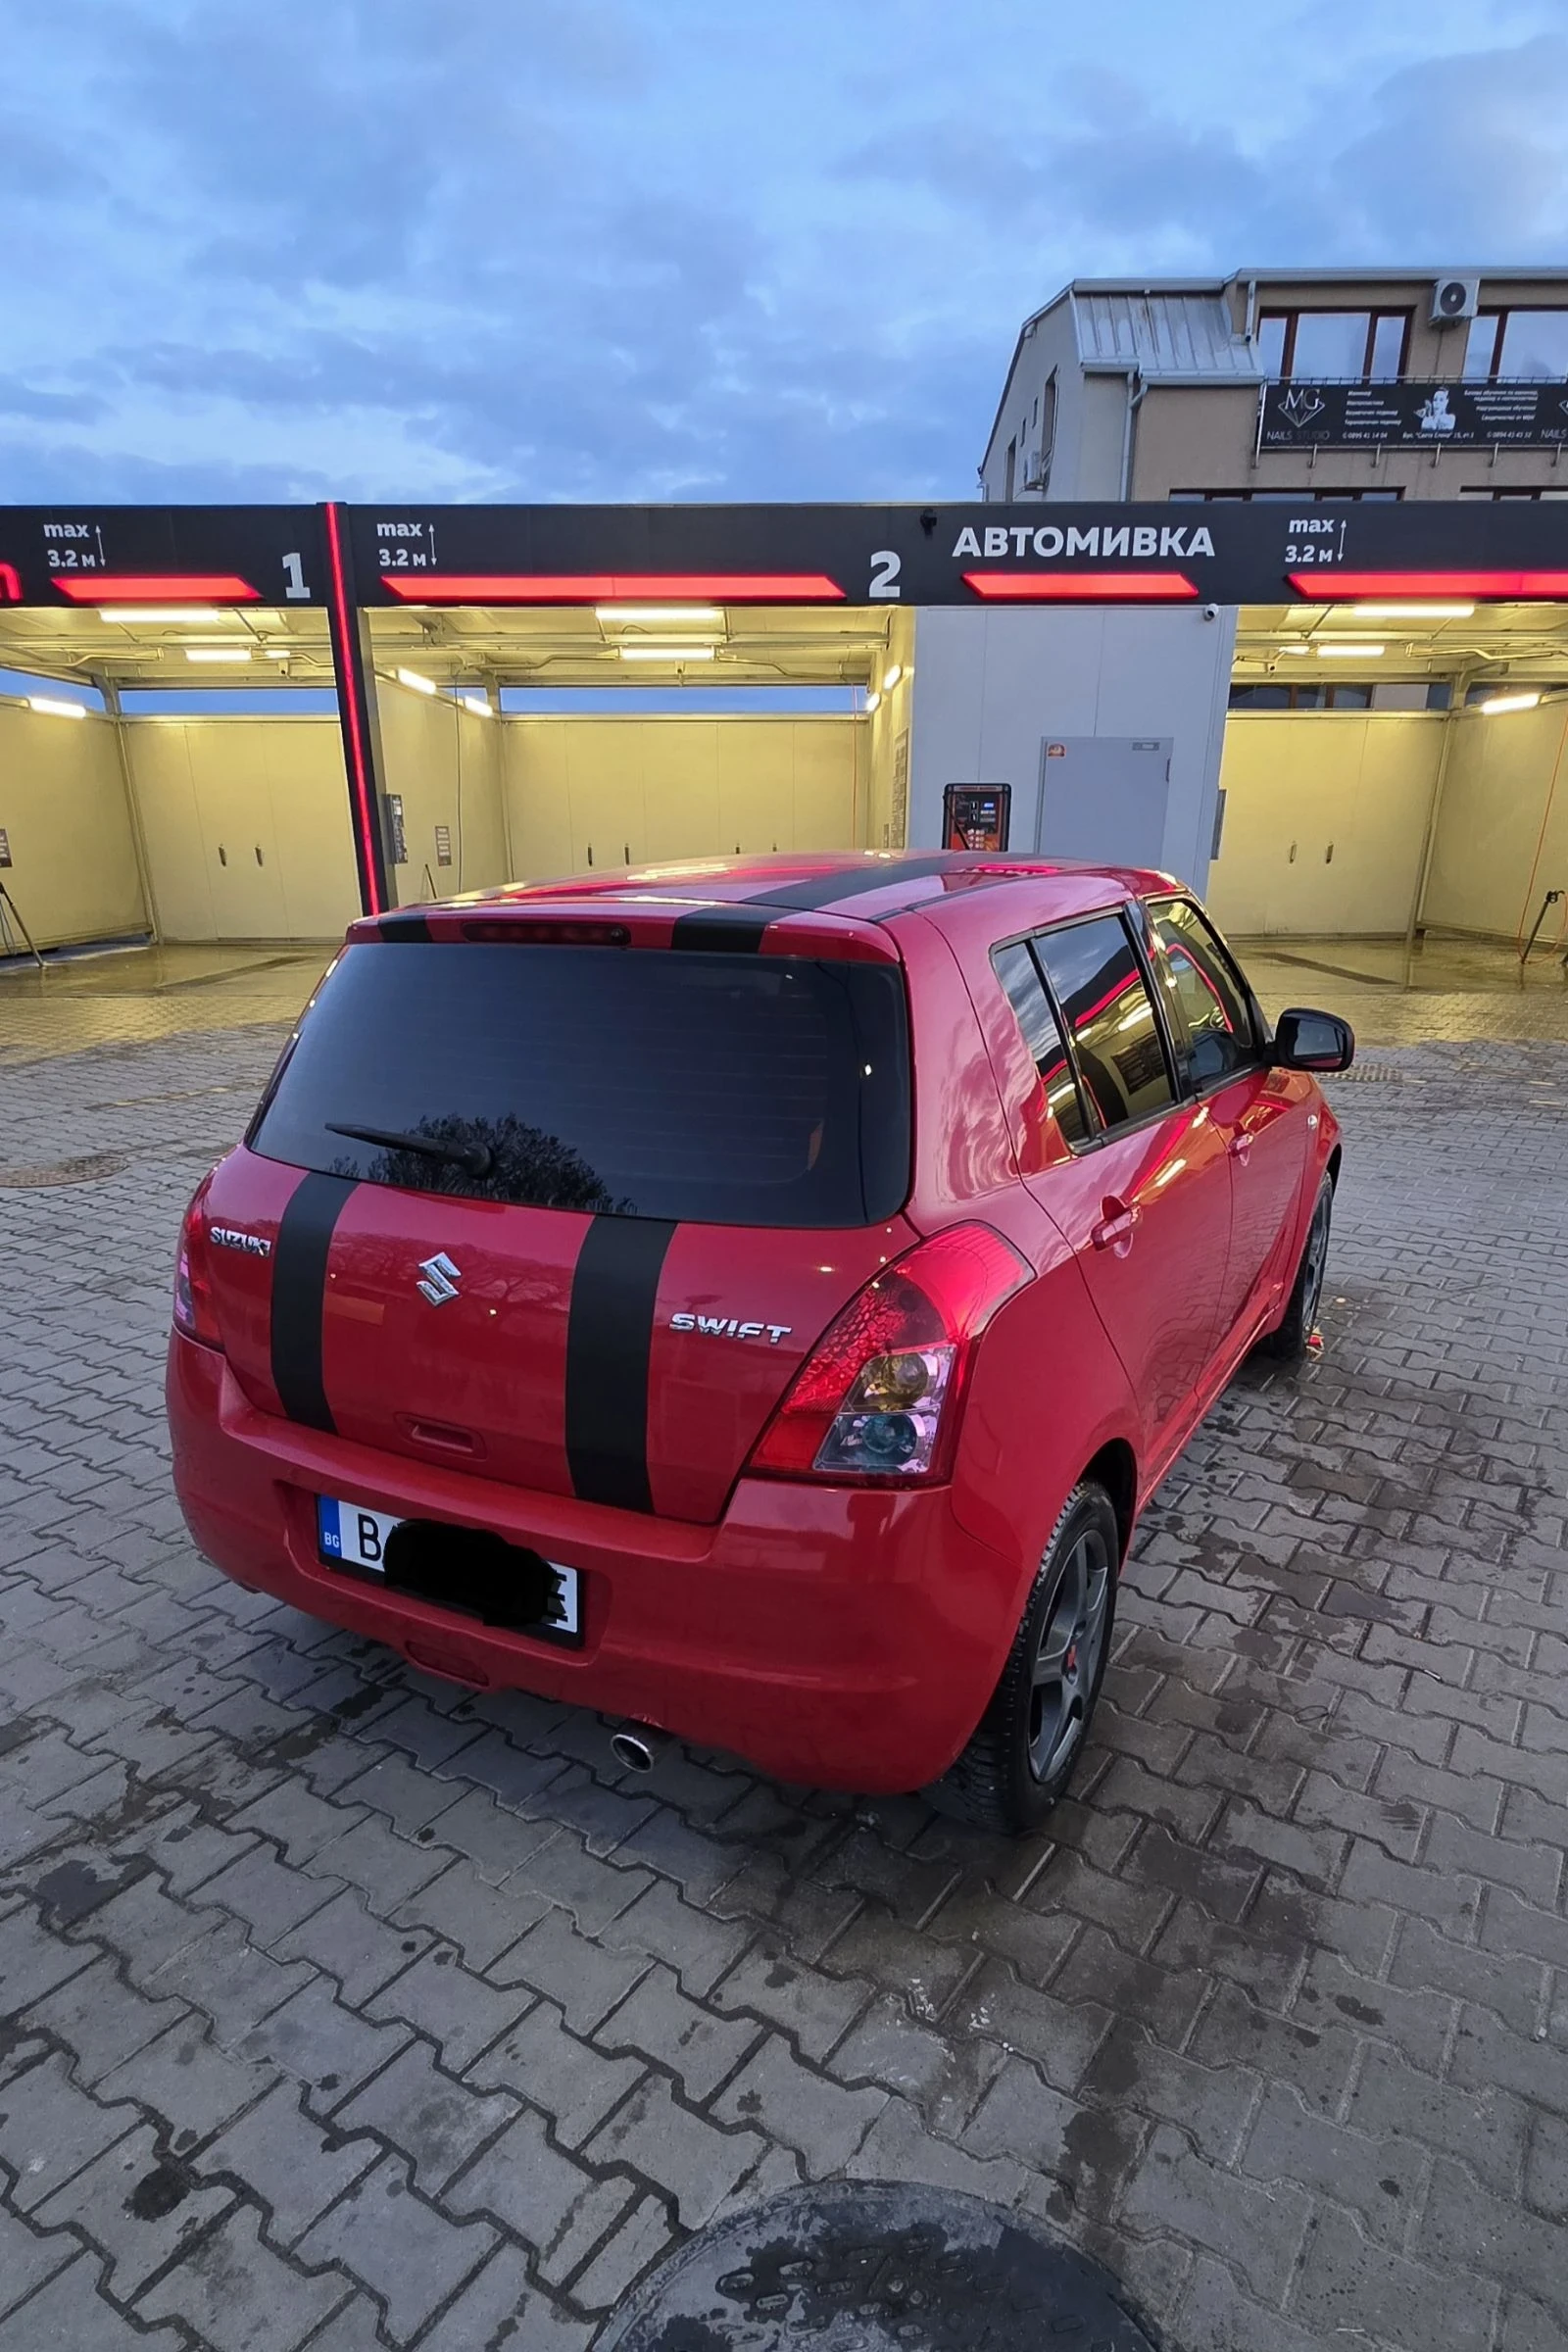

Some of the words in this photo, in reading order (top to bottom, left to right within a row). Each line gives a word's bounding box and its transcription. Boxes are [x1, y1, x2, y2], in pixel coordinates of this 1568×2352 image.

[1266, 430, 1294, 440] NAILS
[1540, 428, 1567, 439] NAILS
[43, 523, 90, 538] max
[376, 522, 422, 537] max
[1289, 518, 1335, 533] max
[952, 525, 1215, 558] АВТОМИВКА
[47, 549, 78, 567] 3.2
[378, 548, 409, 566] 3.2
[1285, 544, 1315, 563] 3.2
[281, 552, 311, 599] 1
[869, 550, 901, 598] 2
[210, 1226, 271, 1257] SUZUKI
[668, 1312, 792, 1344] SWIFT
[324, 1532, 340, 1548] BG
